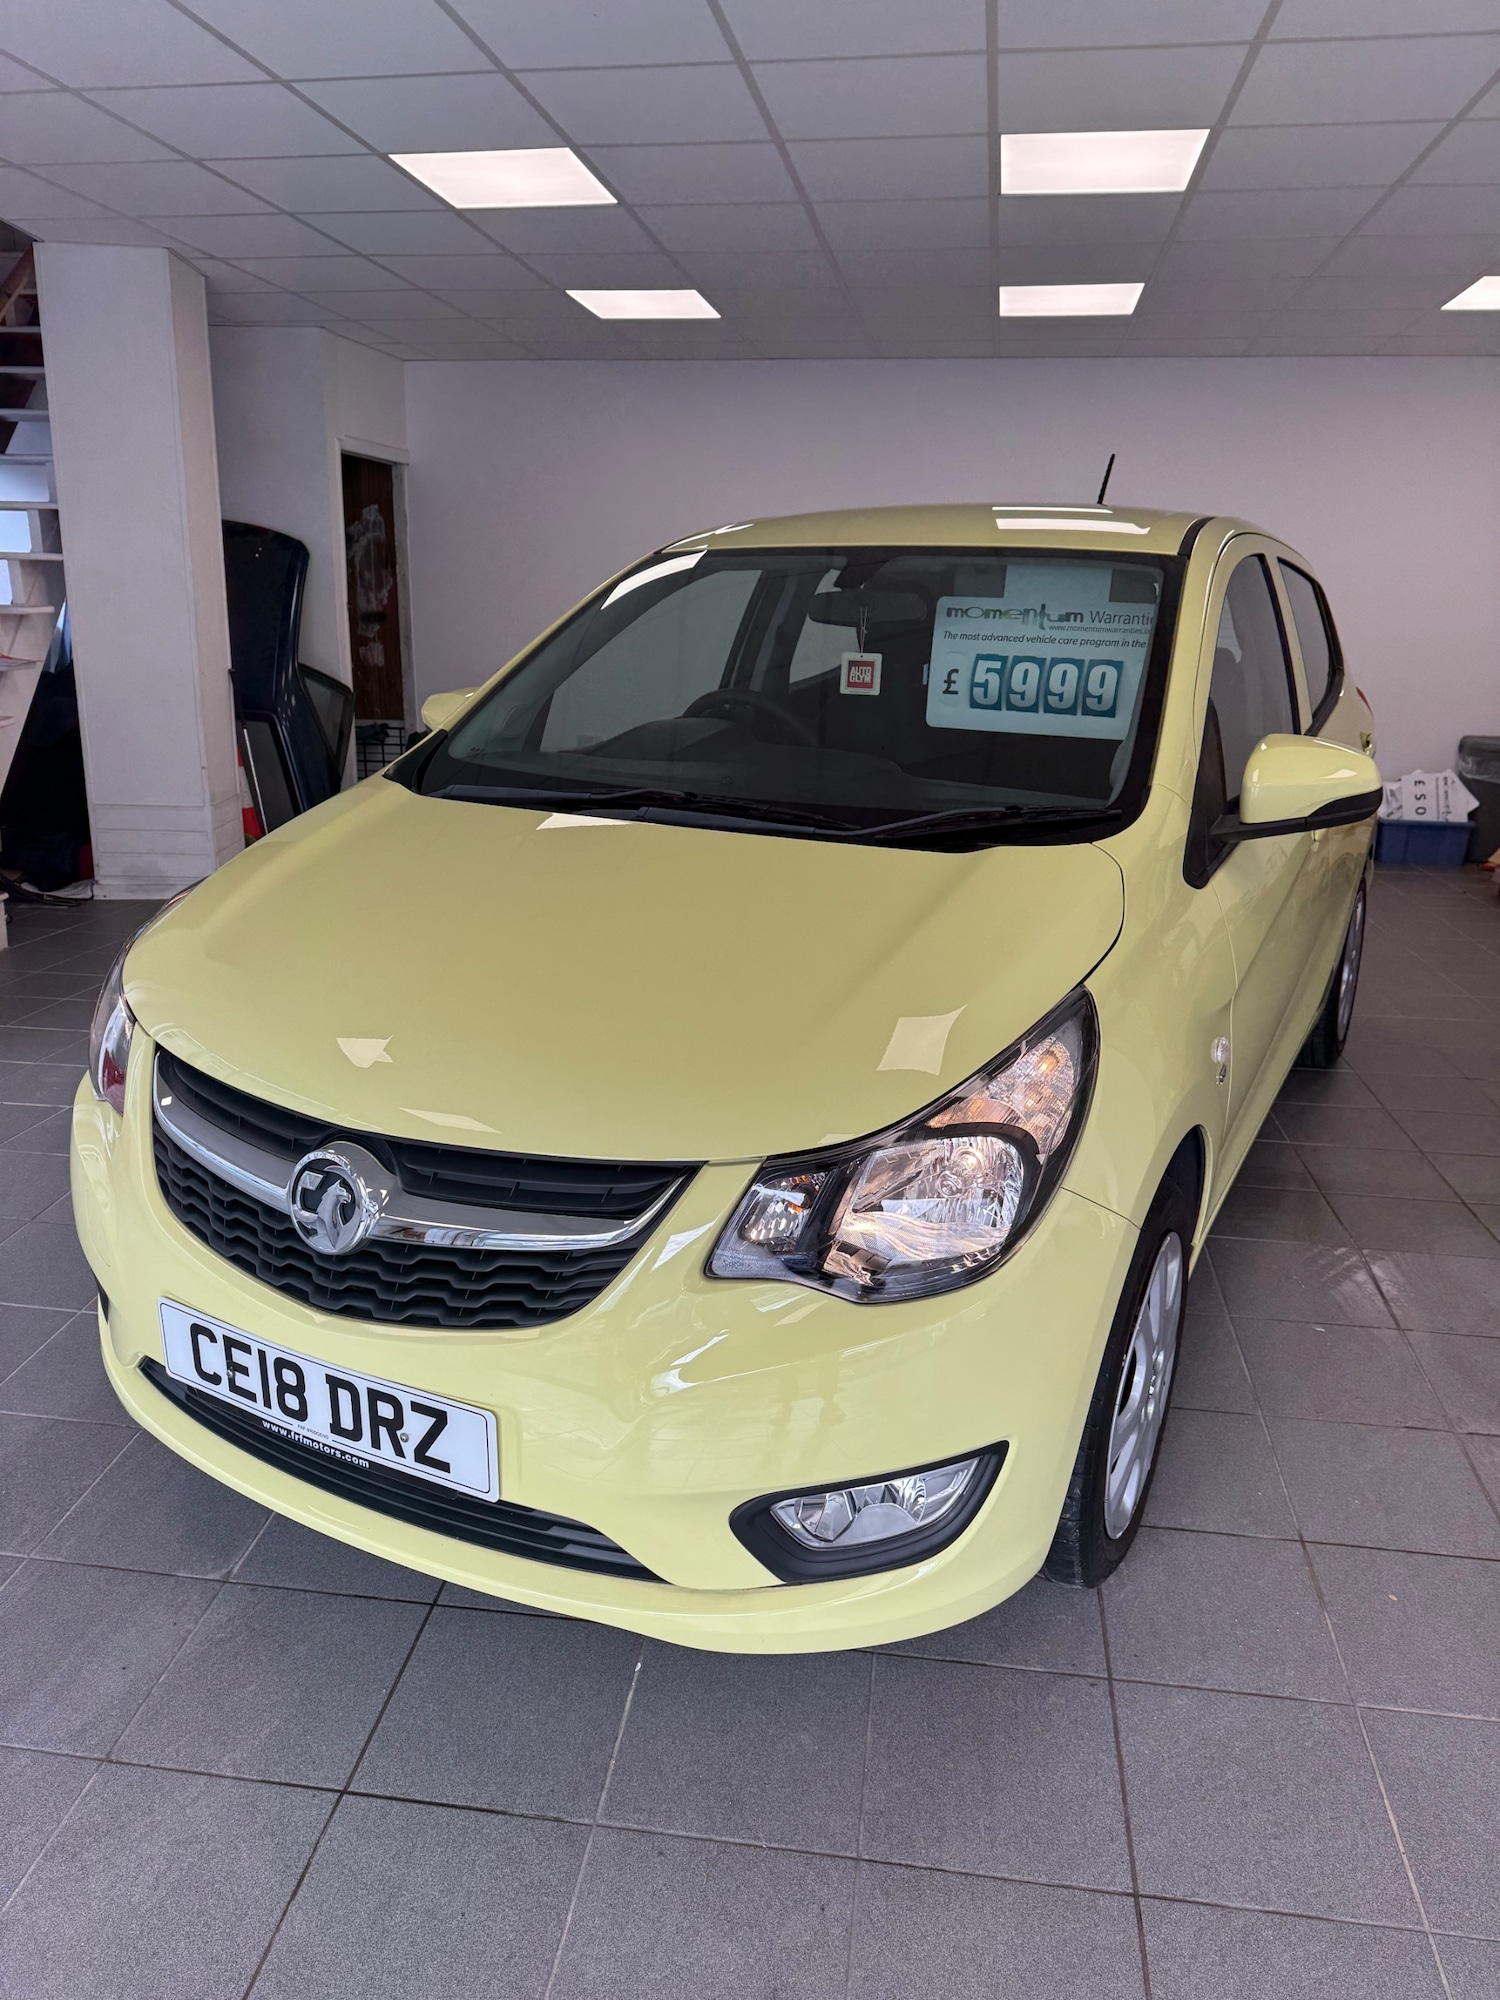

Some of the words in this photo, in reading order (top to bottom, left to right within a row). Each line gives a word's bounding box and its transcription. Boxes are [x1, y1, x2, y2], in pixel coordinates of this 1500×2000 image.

[946, 604, 1084, 630] momentum
[943, 630, 958, 641] The
[959, 632, 980, 642] most
[981, 633, 1024, 644] advanced
[1026, 634, 1056, 645] vehicle
[1058, 637, 1078, 646] care
[1079, 638, 1120, 648] program
[1121, 638, 1130, 647] in
[1131, 639, 1147, 648] the
[849, 673, 872, 683] GLYM
[850, 666, 872, 675] AUTO
[189, 1322, 309, 1423] CE18
[325, 1372, 451, 1474] DRZ
[261, 1419, 370, 1468] www.frfmotors.com
